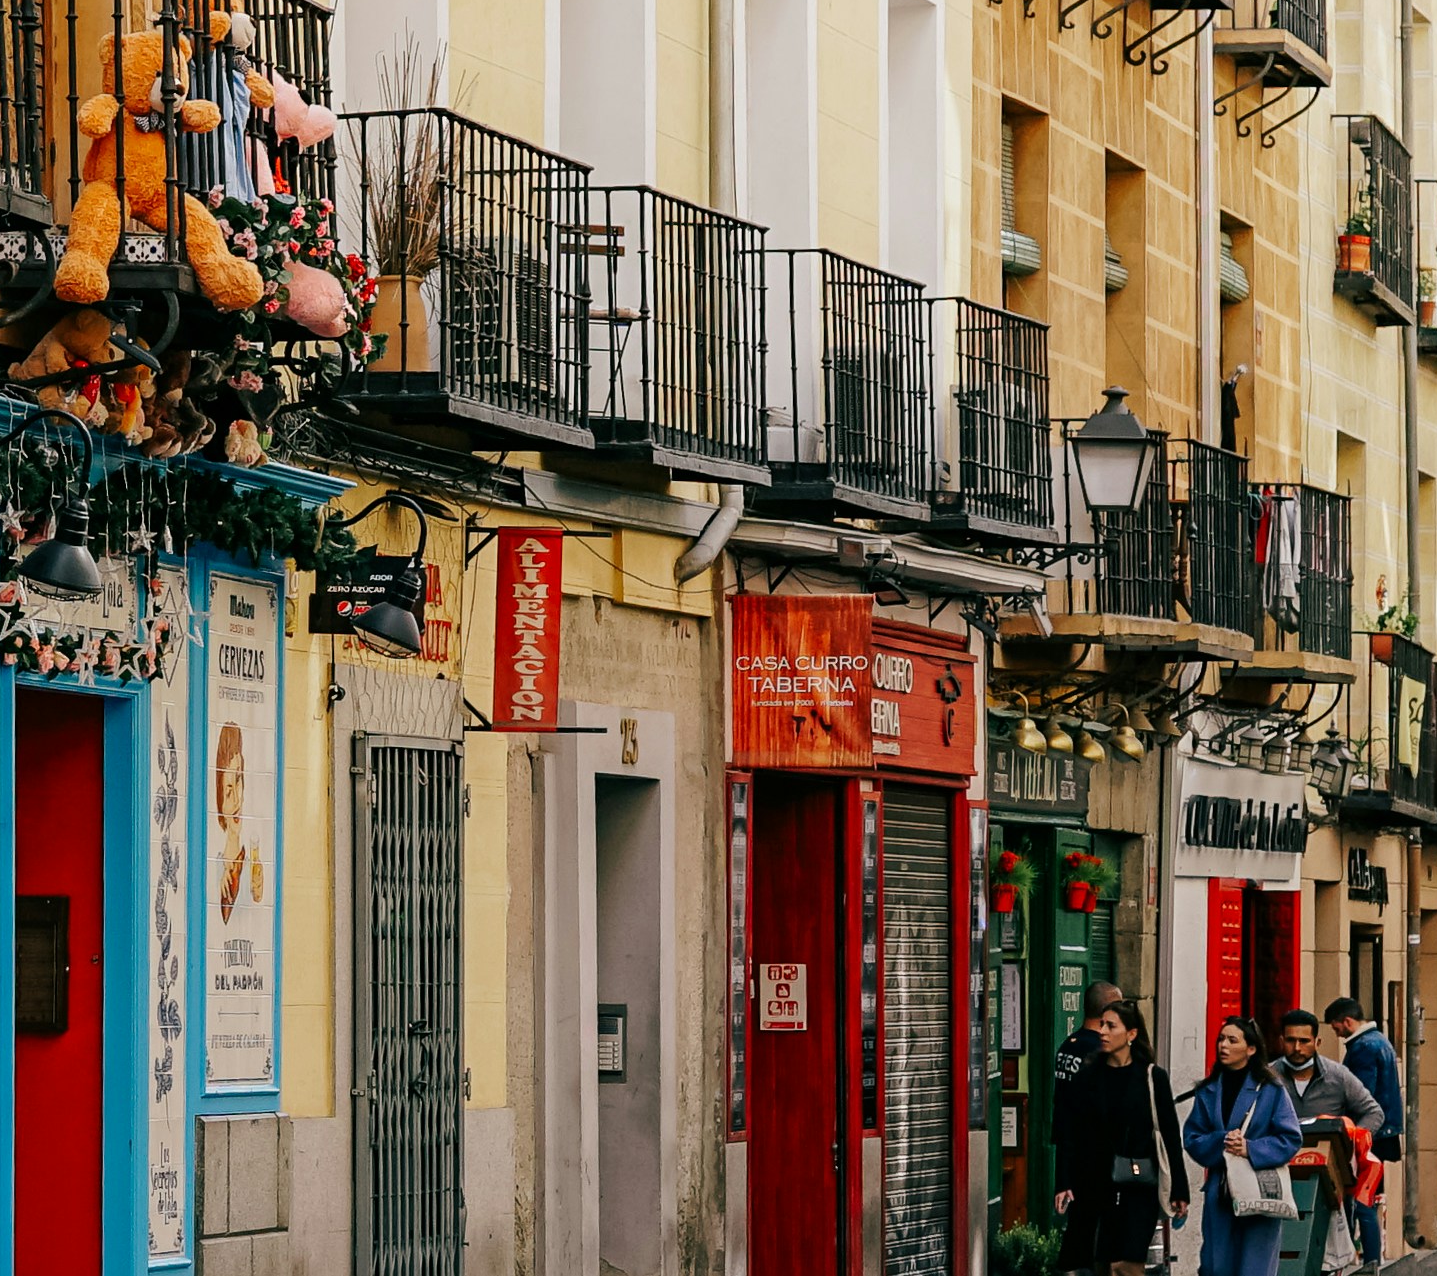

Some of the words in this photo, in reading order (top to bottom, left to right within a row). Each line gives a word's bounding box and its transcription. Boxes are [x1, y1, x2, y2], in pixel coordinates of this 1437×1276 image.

[101, 580, 124, 619] Lola
[511, 538, 550, 721] ALIMENTACION
[219, 643, 265, 683] CERVEZAS
[736, 656, 791, 671] CASA
[795, 656, 869, 671] CURRO
[748, 676, 856, 693] TABERNA
[871, 698, 901, 737] ERNA
[620, 718, 639, 765] 23
[215, 974, 230, 990] DEL
[160, 1141, 170, 1169] Los
[151, 1164, 178, 1199] Secretos
[165, 1190, 178, 1225] Lola
